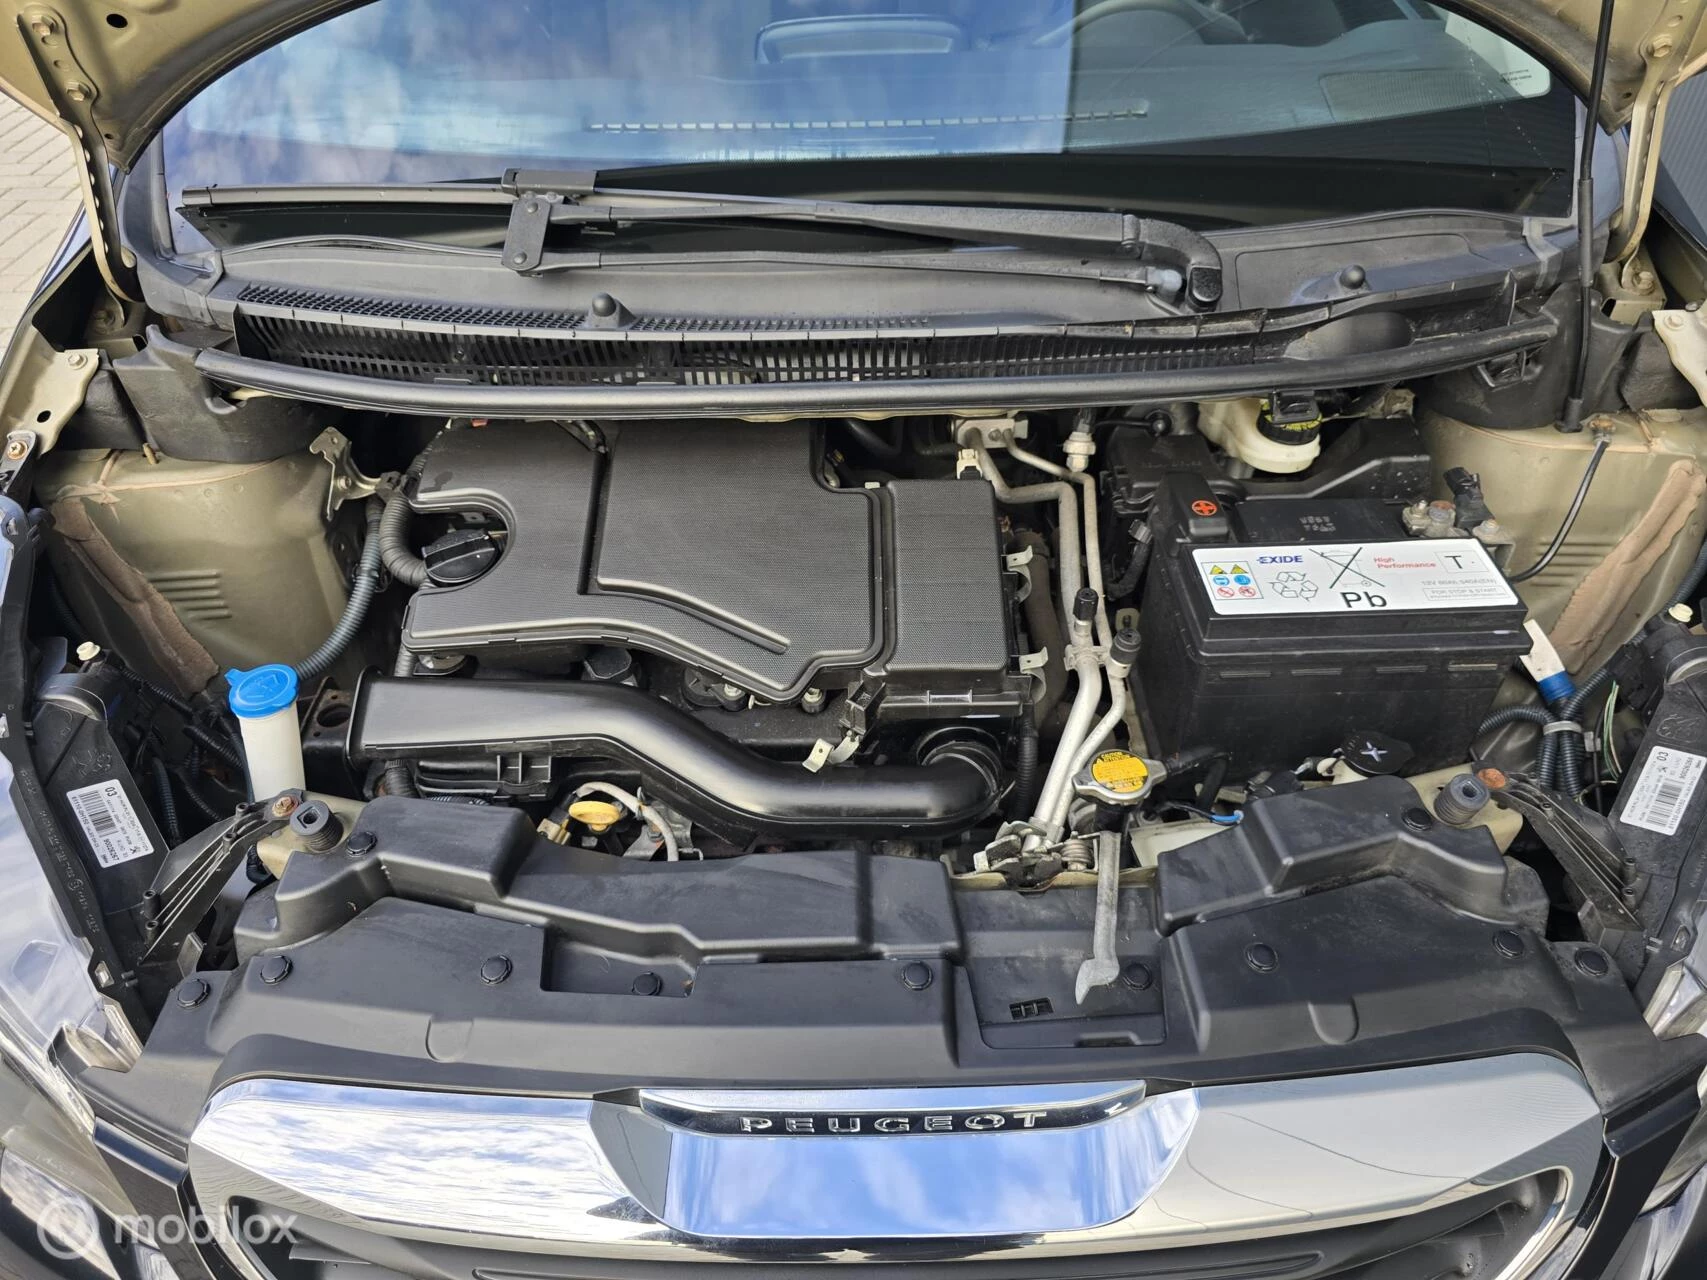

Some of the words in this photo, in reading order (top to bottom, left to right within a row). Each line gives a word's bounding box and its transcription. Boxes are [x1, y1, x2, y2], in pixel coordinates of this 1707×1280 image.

[1257, 555, 1303, 564] EXIDE
[1444, 555, 1463, 569] T
[1340, 591, 1387, 608] Pb
[1656, 751, 1669, 762] 03
[104, 786, 118, 797] 03
[740, 1111, 1047, 1132] PEUGEOT
